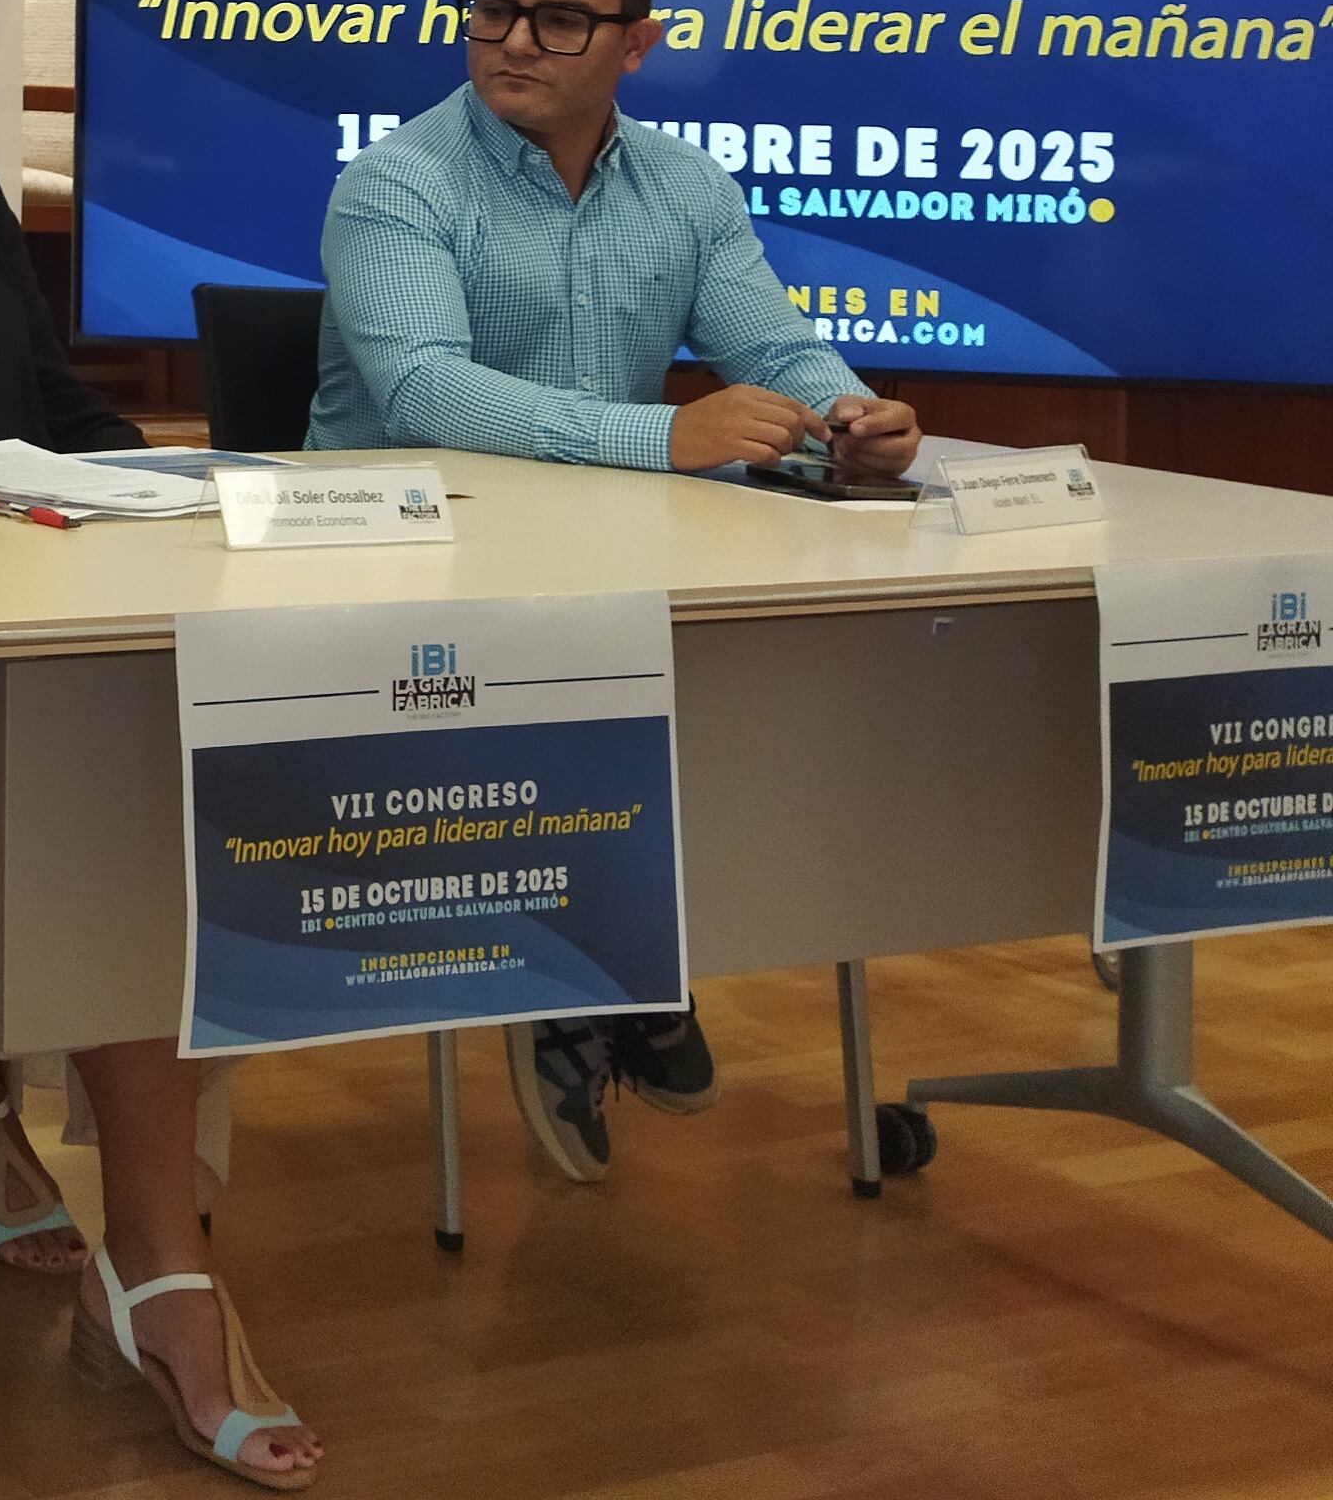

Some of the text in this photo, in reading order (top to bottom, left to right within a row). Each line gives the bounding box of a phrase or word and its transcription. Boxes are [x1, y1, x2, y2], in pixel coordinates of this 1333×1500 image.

[856, 126, 938, 178] DE
[959, 128, 1115, 183] 2025
[779, 186, 975, 221] SALVADOR
[986, 186, 1087, 225] MIRÓ
[890, 290, 940, 318] EN
[331, 780, 538, 820] VII CONGRESO
[225, 804, 642, 864] “Innovar hoy para liderar el mañana”
[301, 866, 568, 914] 15 DE OCTUBRE DE 2025
